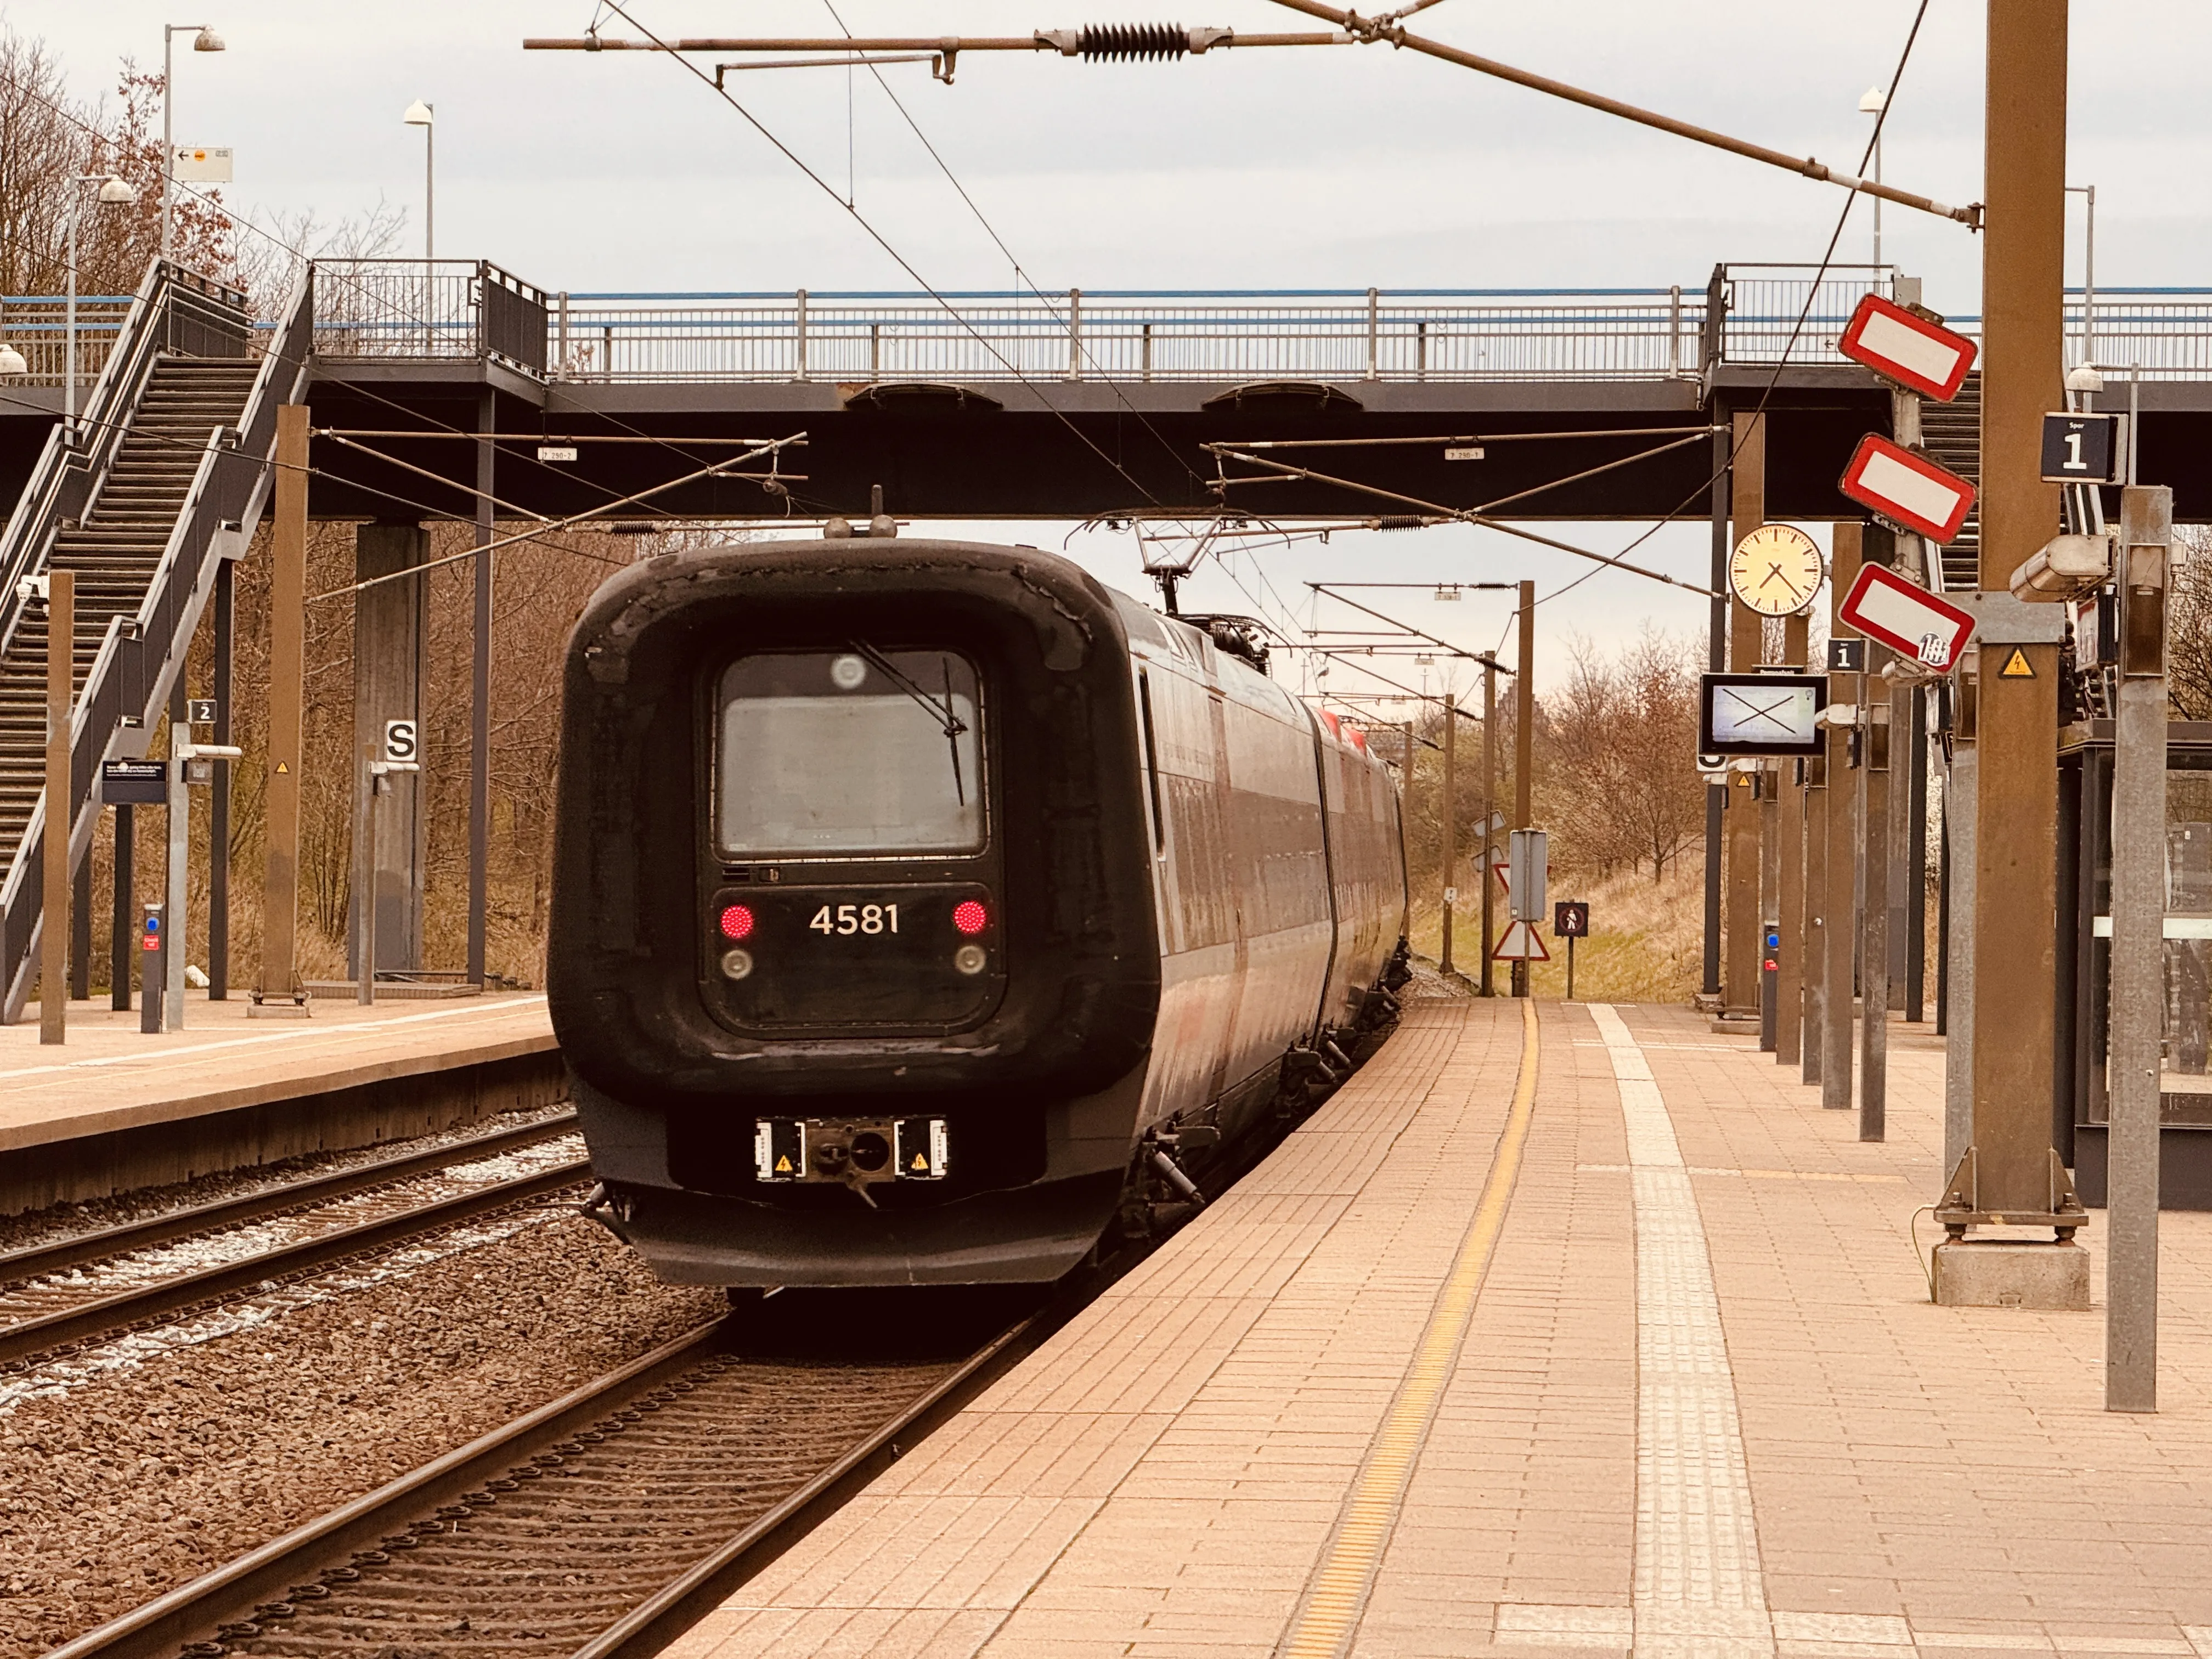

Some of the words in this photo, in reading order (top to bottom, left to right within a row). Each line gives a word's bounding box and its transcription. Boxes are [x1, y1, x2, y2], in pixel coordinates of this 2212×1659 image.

[2069, 421, 2085, 430] Spor
[2063, 433, 2087, 470] 1
[1837, 648, 1850, 668] 1
[200, 706, 210, 720] 2
[387, 724, 414, 757] S
[809, 904, 898, 935] 4581
